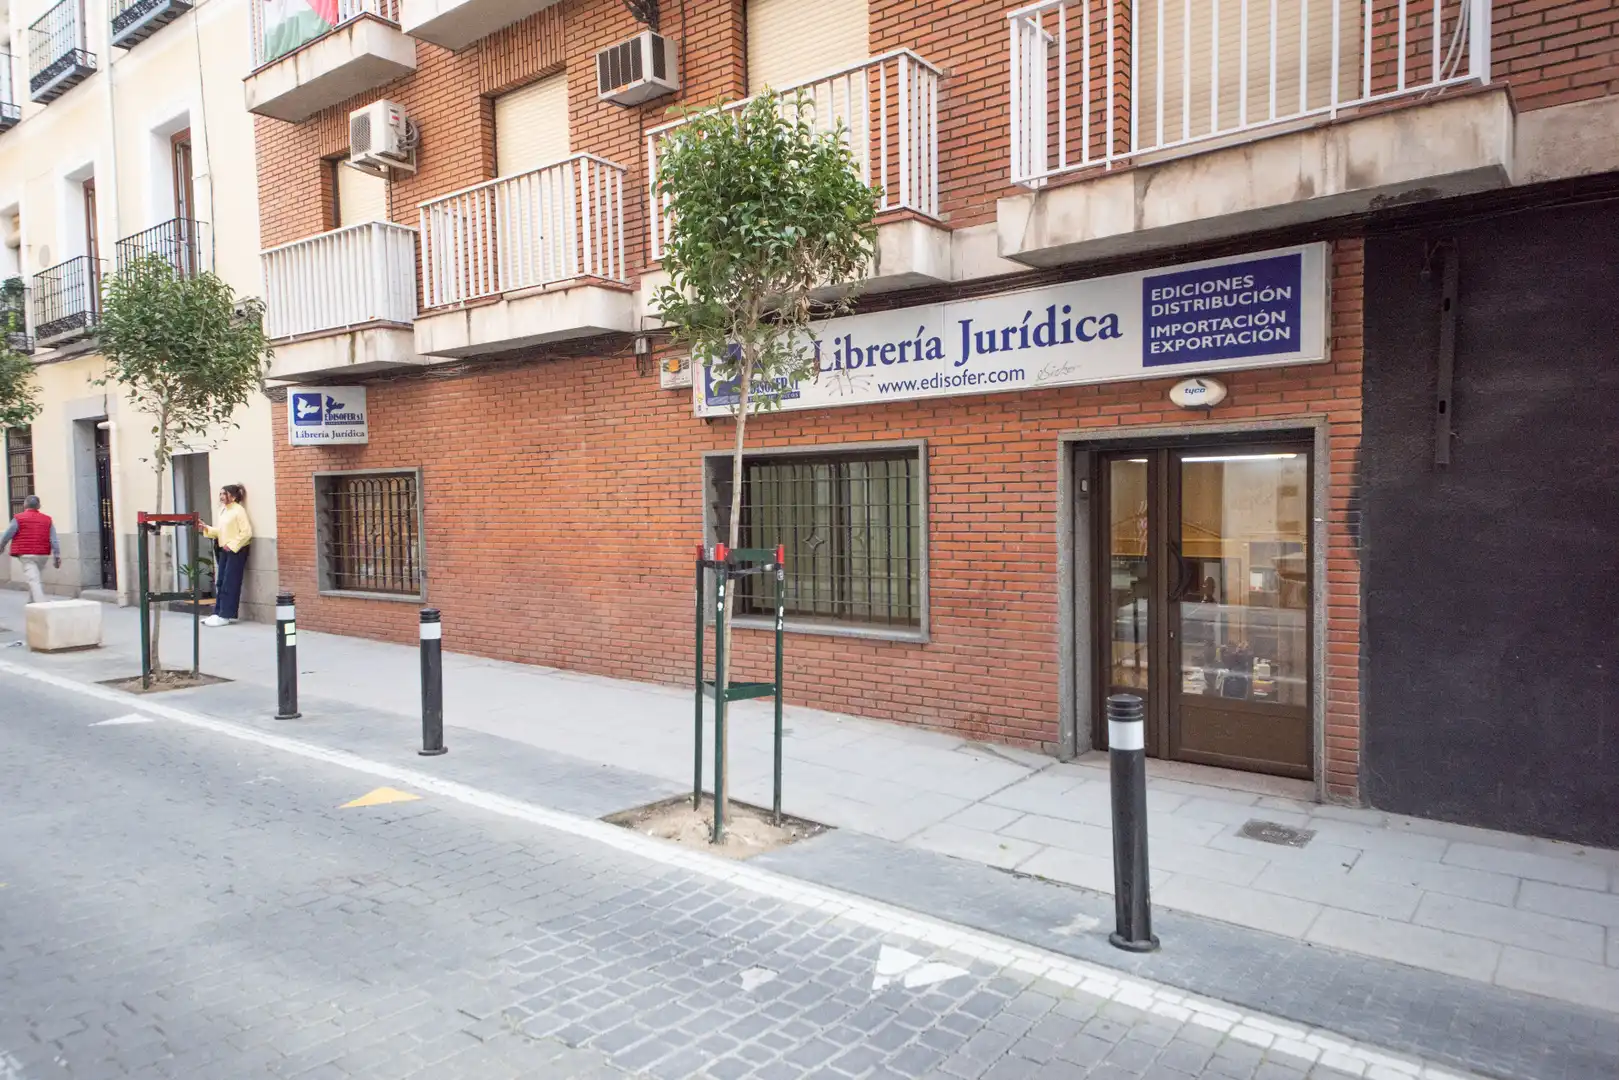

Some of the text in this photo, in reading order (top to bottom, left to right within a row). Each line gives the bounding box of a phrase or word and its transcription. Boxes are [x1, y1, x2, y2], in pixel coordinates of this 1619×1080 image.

[1151, 275, 1255, 301] EDICIONES
[1151, 285, 1292, 317] DISTRIBUCIÓN
[1150, 309, 1286, 339] IMPORTACIÓN
[811, 304, 1124, 373] Librería Jurídica
[1150, 325, 1291, 354] EXPORTACIÓN
[877, 368, 1025, 394] www.edisofer.com
[1184, 387, 1206, 395] tyco
[330, 429, 365, 440] Jurídica
